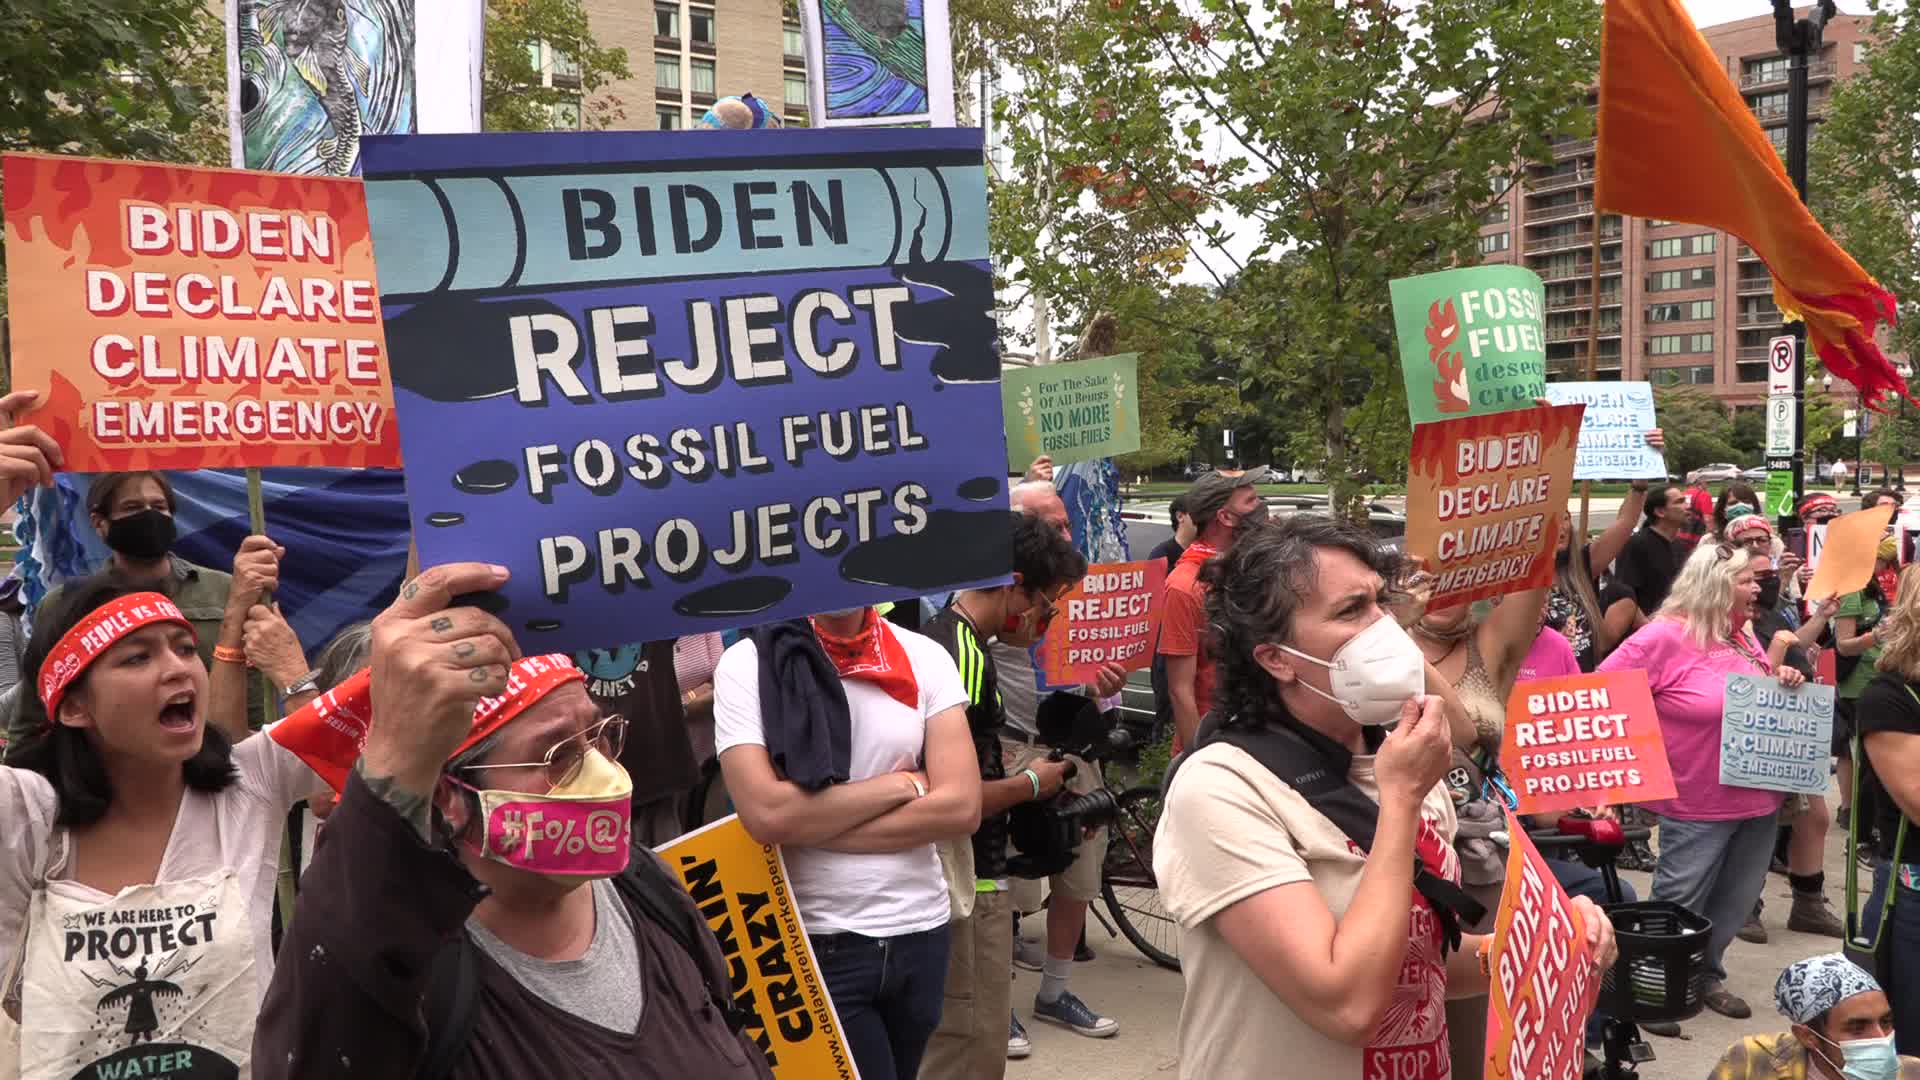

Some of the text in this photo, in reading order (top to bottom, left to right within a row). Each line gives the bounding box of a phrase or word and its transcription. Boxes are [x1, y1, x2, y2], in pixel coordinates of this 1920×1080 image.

[127, 205, 333, 263] BIDEN
[562, 179, 848, 260] BIDEN
[86, 270, 377, 322] DECLARE
[1461, 288, 1544, 324] FOSSI
[91, 334, 381, 385] CLIMATE
[509, 287, 910, 403] REJECT
[1040, 376, 1108, 394] For The Sake
[1040, 390, 1109, 409] Of All Beings
[94, 400, 381, 442] EMERGENCY
[1040, 403, 1110, 433] NO MORE
[1583, 414, 1639, 428] CLARE
[524, 405, 926, 495] FOSSIL FUEL
[1043, 426, 1111, 452] FOSSIL FUELS
[1457, 433, 1539, 476] BIDEN
[1577, 433, 1643, 448] LIMATE
[1576, 454, 1644, 468] MERGENCY
[1438, 474, 1551, 519] DECLARE
[539, 484, 929, 596] PROJECTS
[1438, 514, 1543, 562] CLIMATE
[1083, 571, 1144, 594] BIDEN
[1431, 553, 1534, 593] EMERGENCY
[1068, 593, 1153, 621] REJECT
[80, 611, 134, 655] PEOPLE
[130, 605, 158, 620] VS.
[1069, 621, 1150, 642] FOSSIL FUEL
[1069, 640, 1147, 664] PROJECTS
[1528, 688, 1610, 715] BIDEN
[1756, 687, 1809, 713] BIDEN
[1516, 714, 1628, 748] REJECT
[1743, 711, 1817, 737] DECLARE
[1520, 746, 1637, 769] FOSSIL FUEL
[1742, 735, 1816, 760] CLIMATE
[1525, 769, 1642, 795] PROJECTS
[1741, 760, 1814, 782] EMERGENCY
[502, 810, 630, 860] #F%@
[84, 903, 195, 928] WE ARE HERE TO
[1500, 852, 1545, 1008] BIDEN
[64, 912, 217, 962] PROTECT
[736, 891, 813, 1043] CRAZY
[1510, 884, 1574, 1080] REJECT
[1561, 953, 1592, 1035] FUEL
[96, 1050, 193, 1080] WATER
[1371, 1050, 1431, 1080] STOP
